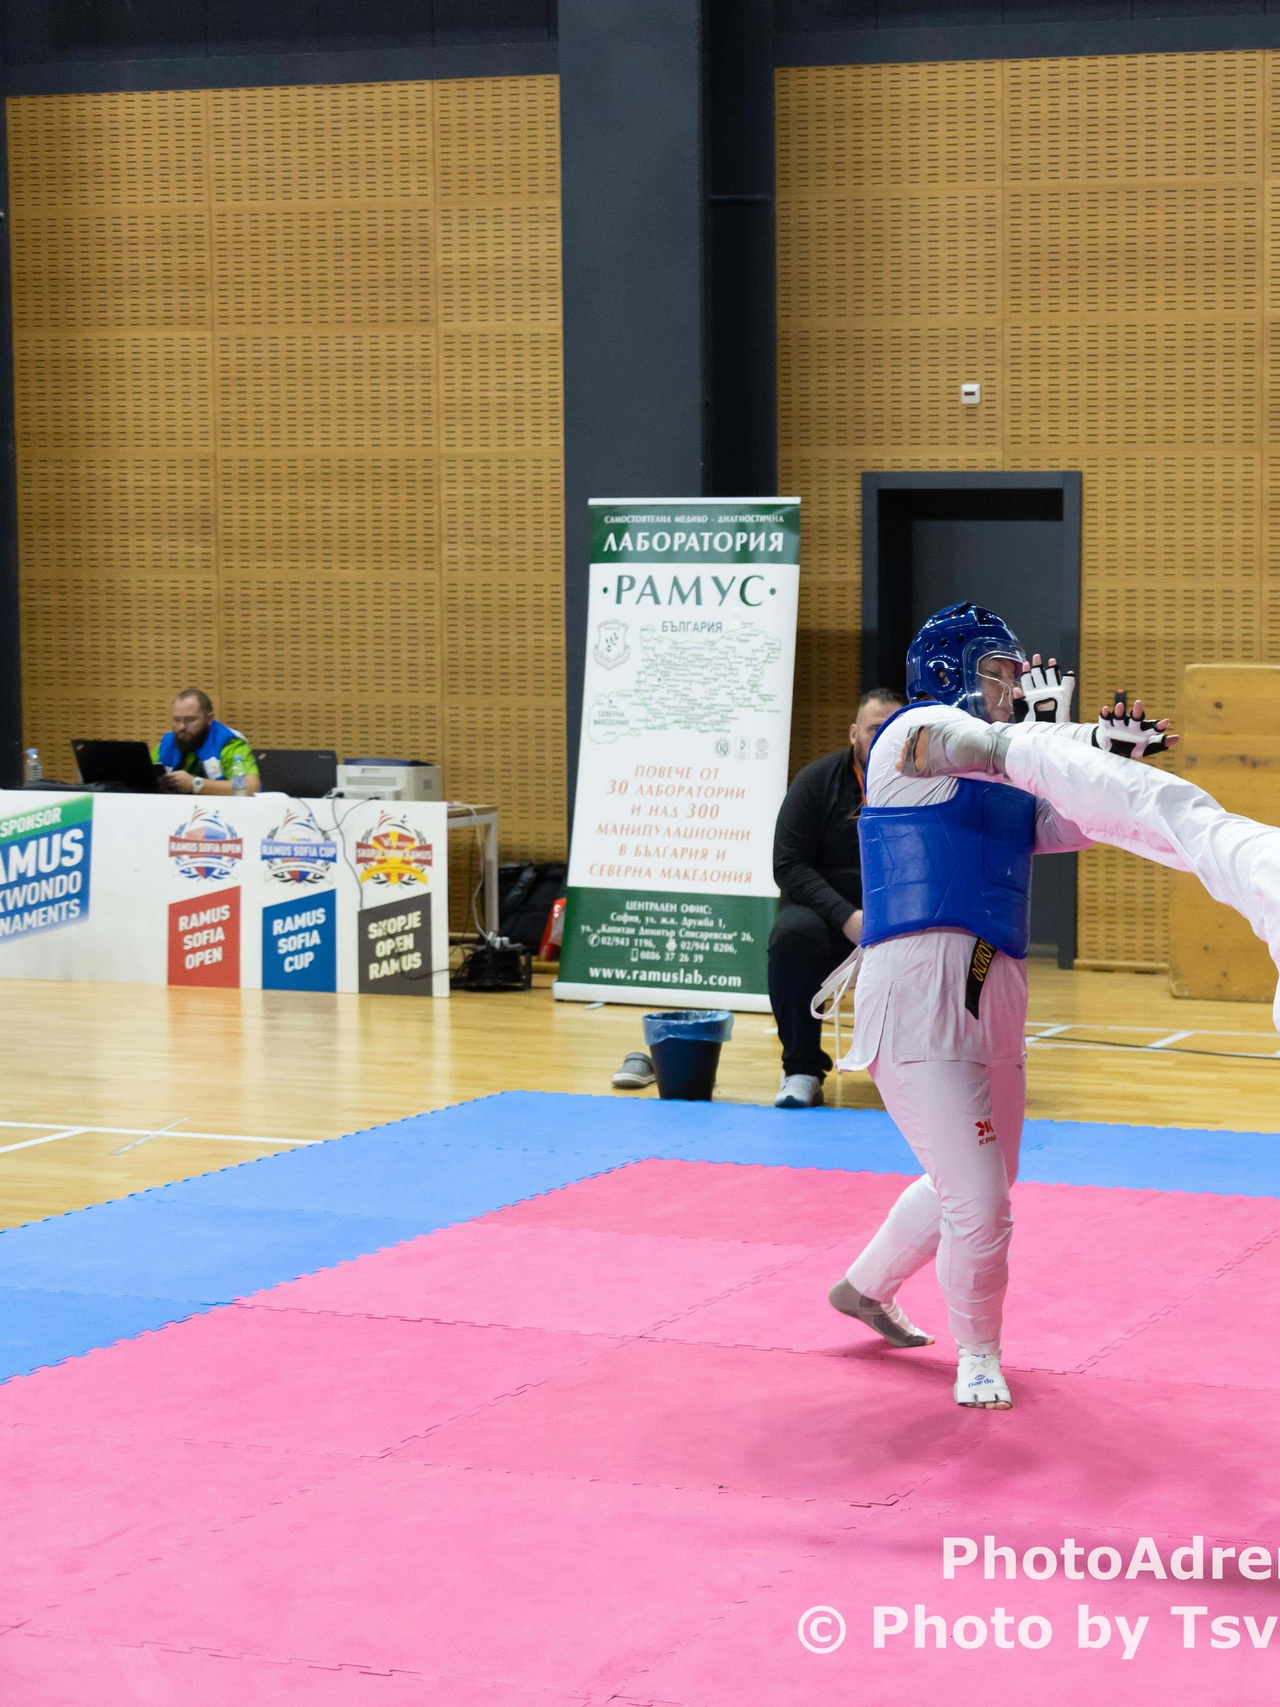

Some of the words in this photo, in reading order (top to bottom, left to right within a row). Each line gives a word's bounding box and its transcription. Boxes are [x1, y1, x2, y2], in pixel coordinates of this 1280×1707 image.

[604, 515, 672, 524] САМОСТОЯТЕЛНА
[675, 515, 708, 523] МЕДИКО
[717, 514, 784, 523] ДИАГНОСТИЧНА
[603, 531, 784, 552] ЛАБОРАТОРИЯ
[661, 621, 723, 633] БЪЛГАРИЯ
[634, 765, 693, 778] ПОВЕЧЕ
[700, 767, 720, 780] ОТ
[607, 779, 629, 795] 30
[635, 784, 746, 800] ЛАБОРАТОРИИ
[631, 804, 641, 816] И
[649, 805, 678, 818] НАД
[686, 803, 720, 820] 300
[0, 807, 62, 838] SPONSOR
[596, 823, 751, 842] МАНИПУЛАЦИОННИ
[618, 844, 628, 857] В
[634, 845, 708, 861] БЪЛГАРИЯ
[716, 849, 727, 861] И
[589, 863, 652, 879] СЕВЕРНА
[660, 868, 753, 884] МАКЕДОНИЯ
[178, 904, 230, 931] RAMUS
[625, 901, 677, 912] ЦЕНТРАЛЕН
[680, 903, 713, 915] ОФИС:
[272, 907, 326, 936] RAMUS
[368, 910, 422, 939] SKOPJE
[183, 929, 226, 951] SOFIA
[277, 930, 321, 955] SOFIA
[375, 933, 414, 958] OPEN
[184, 946, 222, 970] OPEN
[284, 951, 314, 973] CUP
[679, 953, 690, 963] 26
[972, 938, 996, 982] ONDO
[588, 966, 742, 988] www.ramuslab.com
